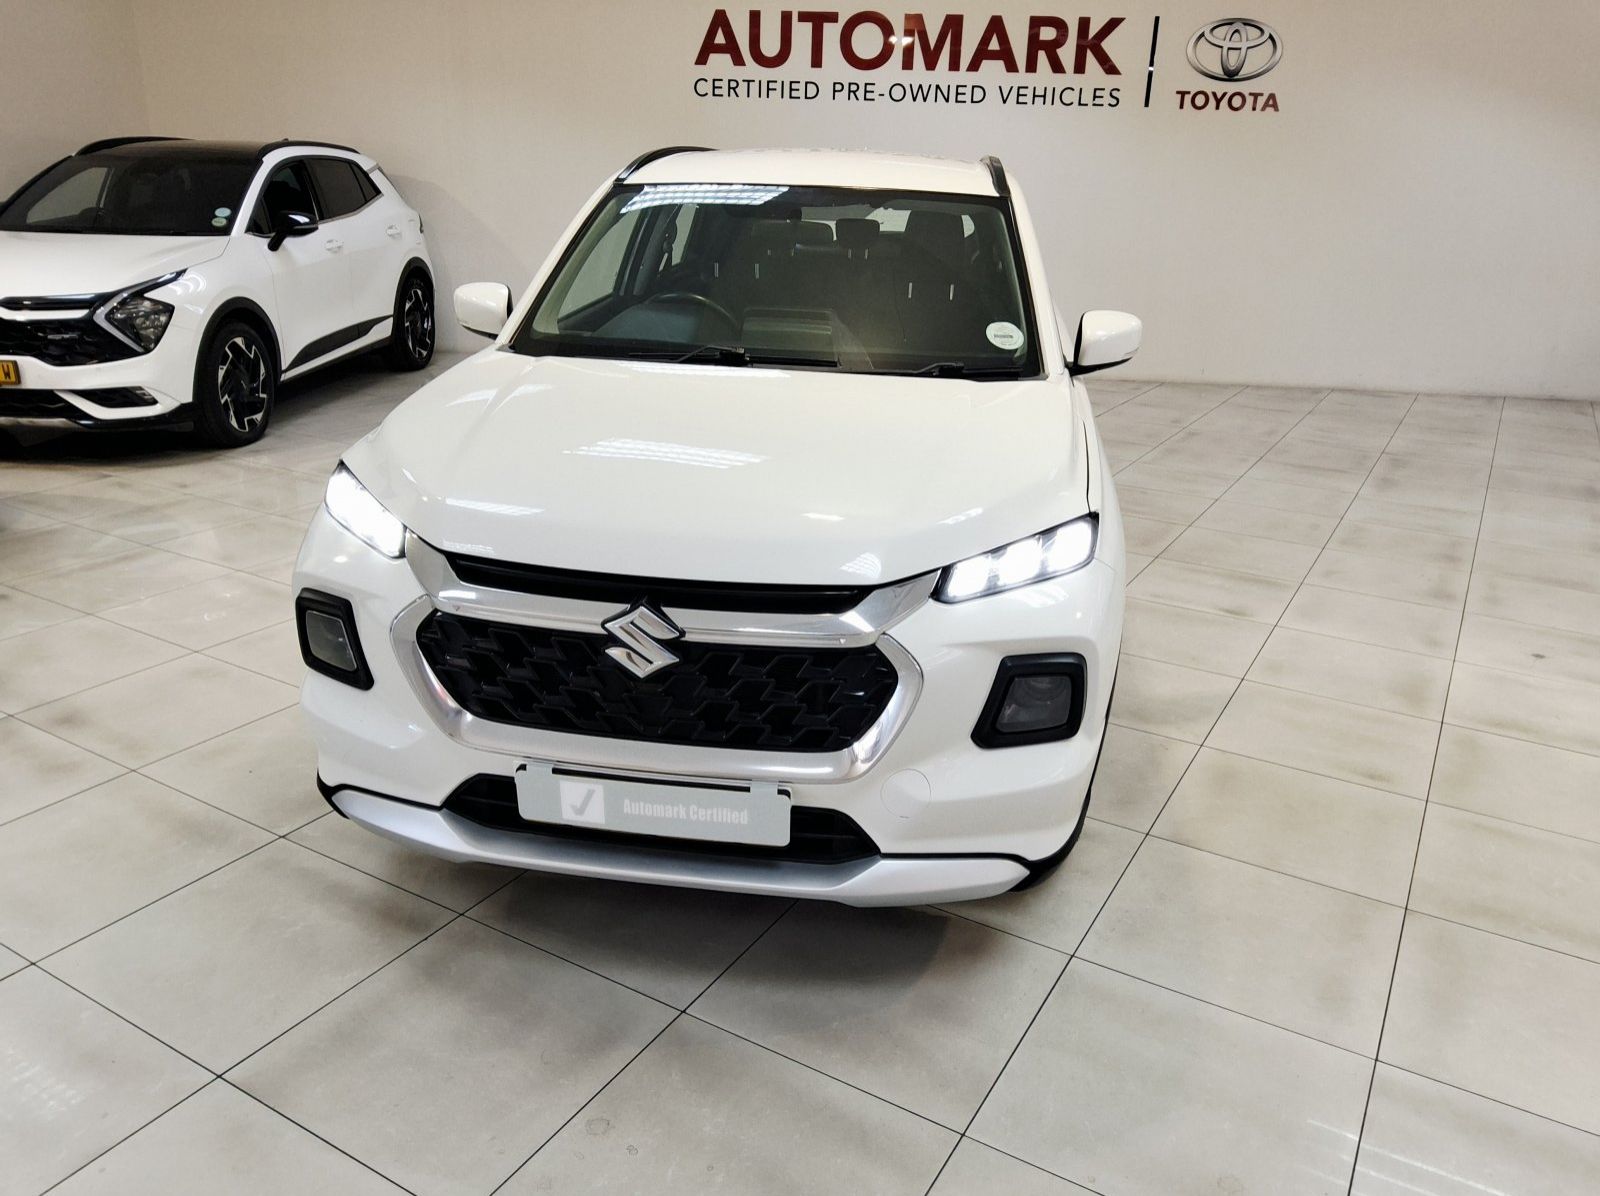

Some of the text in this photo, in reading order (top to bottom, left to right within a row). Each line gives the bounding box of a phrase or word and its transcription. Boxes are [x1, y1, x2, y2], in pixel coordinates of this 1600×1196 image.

[694, 9, 1127, 75] AUTOMARK
[693, 78, 1121, 108] CERTIFIED PRE-OWNED VEHICLES
[1175, 90, 1280, 112] TOYOTA
[623, 798, 749, 825] Automark Certified
